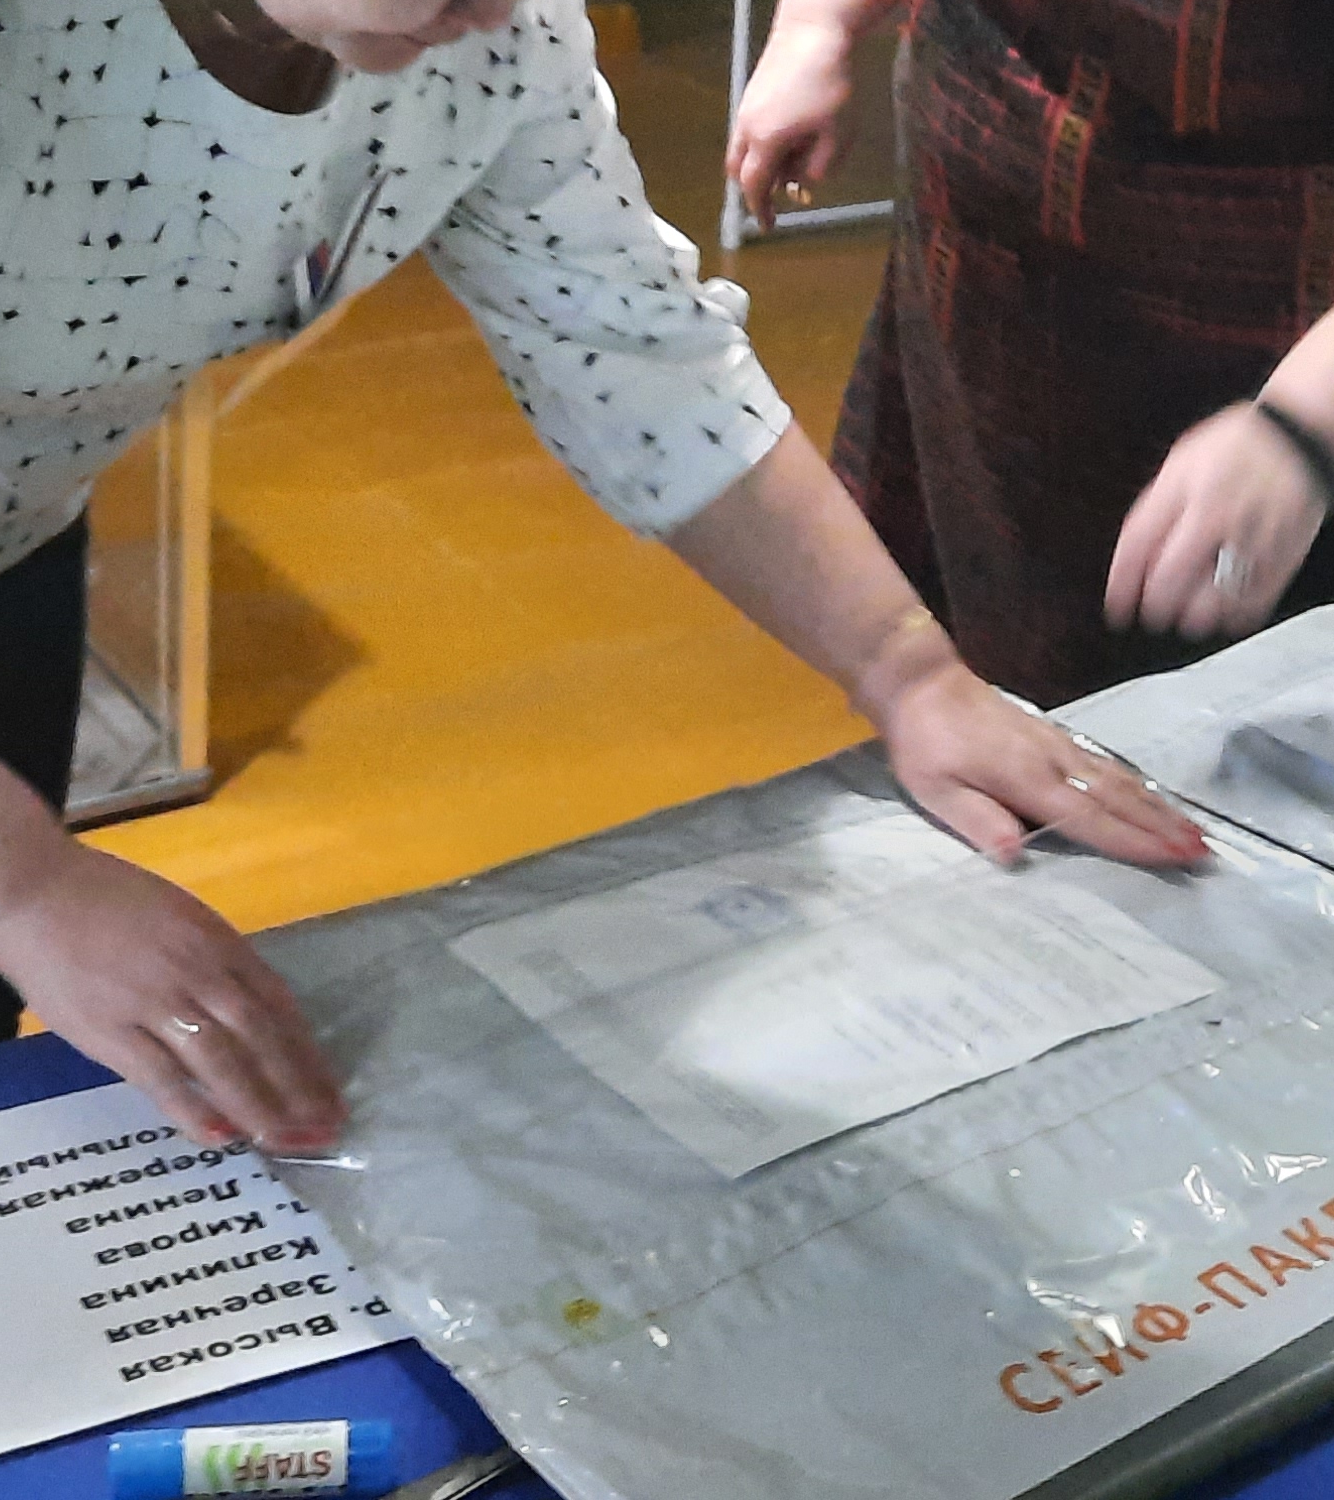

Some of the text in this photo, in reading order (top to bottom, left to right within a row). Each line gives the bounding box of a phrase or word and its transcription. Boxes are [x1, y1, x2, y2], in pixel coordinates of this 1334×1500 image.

[65, 1178, 241, 1235] Ленина
[95, 1211, 267, 1265] Кирова
[80, 1235, 320, 1310] Калинина
[105, 1273, 338, 1344] Заречная
[120, 1313, 339, 1382] Высокая
[233, 1449, 333, 1482] STAFF
